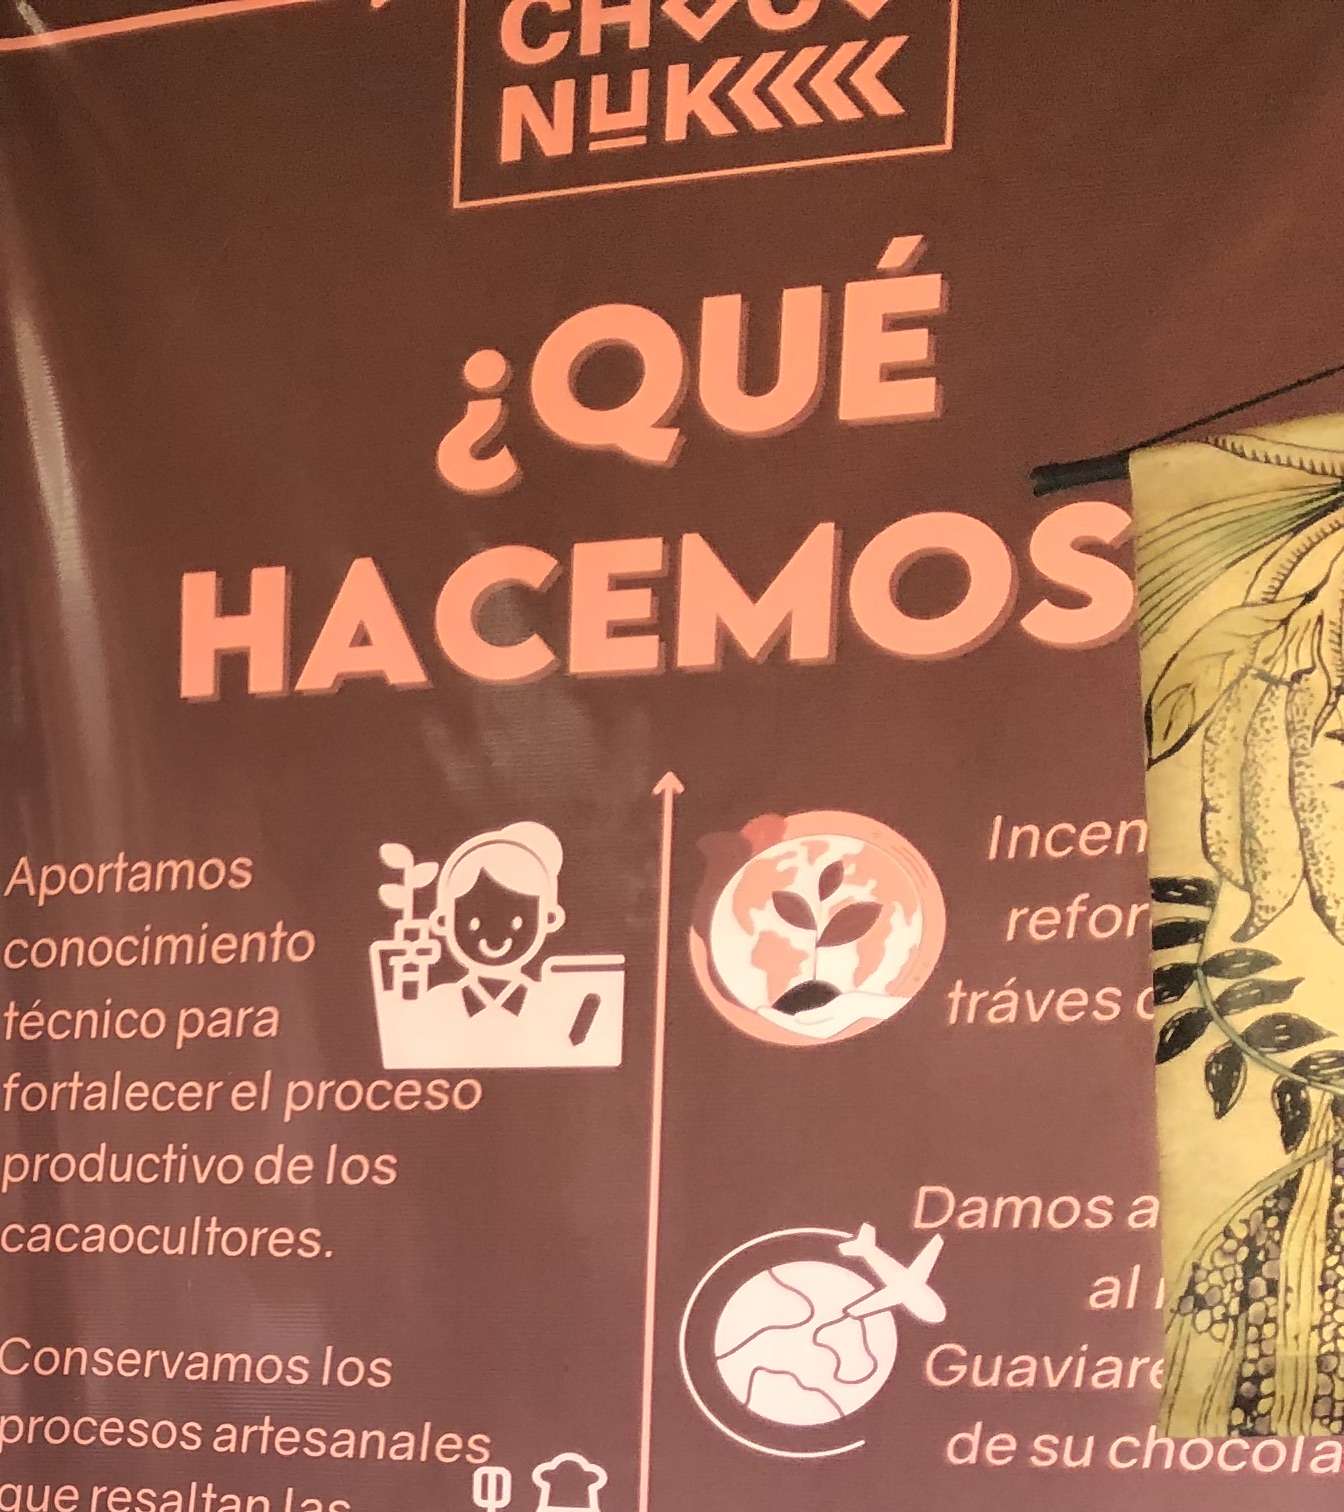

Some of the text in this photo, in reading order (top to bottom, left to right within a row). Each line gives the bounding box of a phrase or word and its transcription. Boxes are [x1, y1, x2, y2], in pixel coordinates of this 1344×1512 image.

[434, 235, 948, 494] ¿QUÉ
[178, 500, 1138, 700] HACEMOS
[3, 852, 254, 906] Aportamos
[3, 921, 315, 969] conocimiento
[4, 998, 280, 1049] técnico para
[947, 978, 1120, 1026] tráves
[3, 1071, 482, 1121] fortalecer el proceso
[1, 1142, 398, 1193] productivo de los
[913, 1185, 1113, 1231] Damos
[0, 1216, 333, 1258] cacaocultores.
[1089, 1264, 1140, 1310] al
[322, 1346, 393, 1389] los
[212, 1415, 492, 1464] artesanales
[946, 1422, 1017, 1467] de
[1029, 1433, 1095, 1468] su
